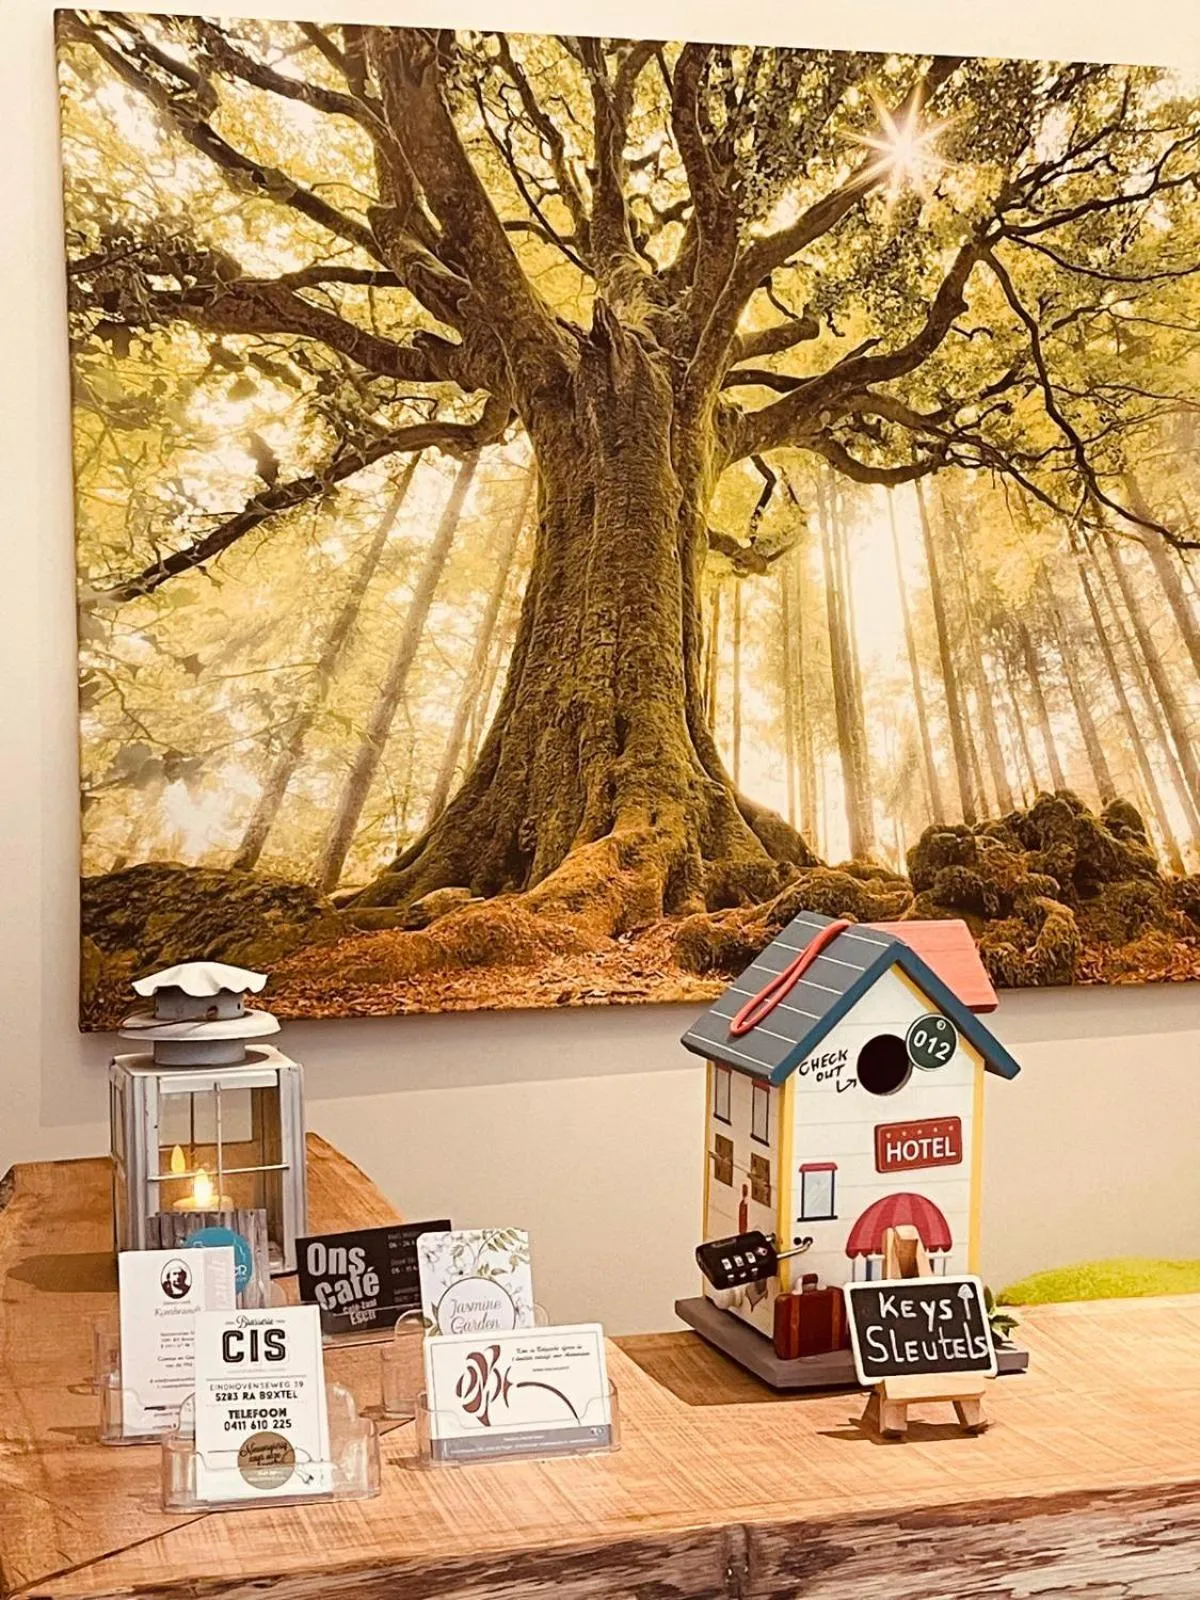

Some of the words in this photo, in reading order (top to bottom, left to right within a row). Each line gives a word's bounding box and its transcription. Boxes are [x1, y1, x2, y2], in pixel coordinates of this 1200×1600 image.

[913, 1029, 951, 1061] 012
[798, 1049, 849, 1077] CHECK
[816, 1064, 846, 1082] OUT
[886, 1136, 957, 1164] HOTEL
[306, 1242, 366, 1276] Ons
[314, 1266, 380, 1311] Café
[450, 1299, 502, 1318] Jasmine
[450, 1312, 500, 1335] Garden
[222, 1328, 287, 1363] CIS
[242, 1391, 256, 1401] RA
[259, 1390, 299, 1400] BOXTEL
[223, 1420, 247, 1432] 0411
[250, 1419, 269, 1430] 610
[272, 1418, 293, 1430] 225
[228, 1407, 288, 1420] TELEFOON
